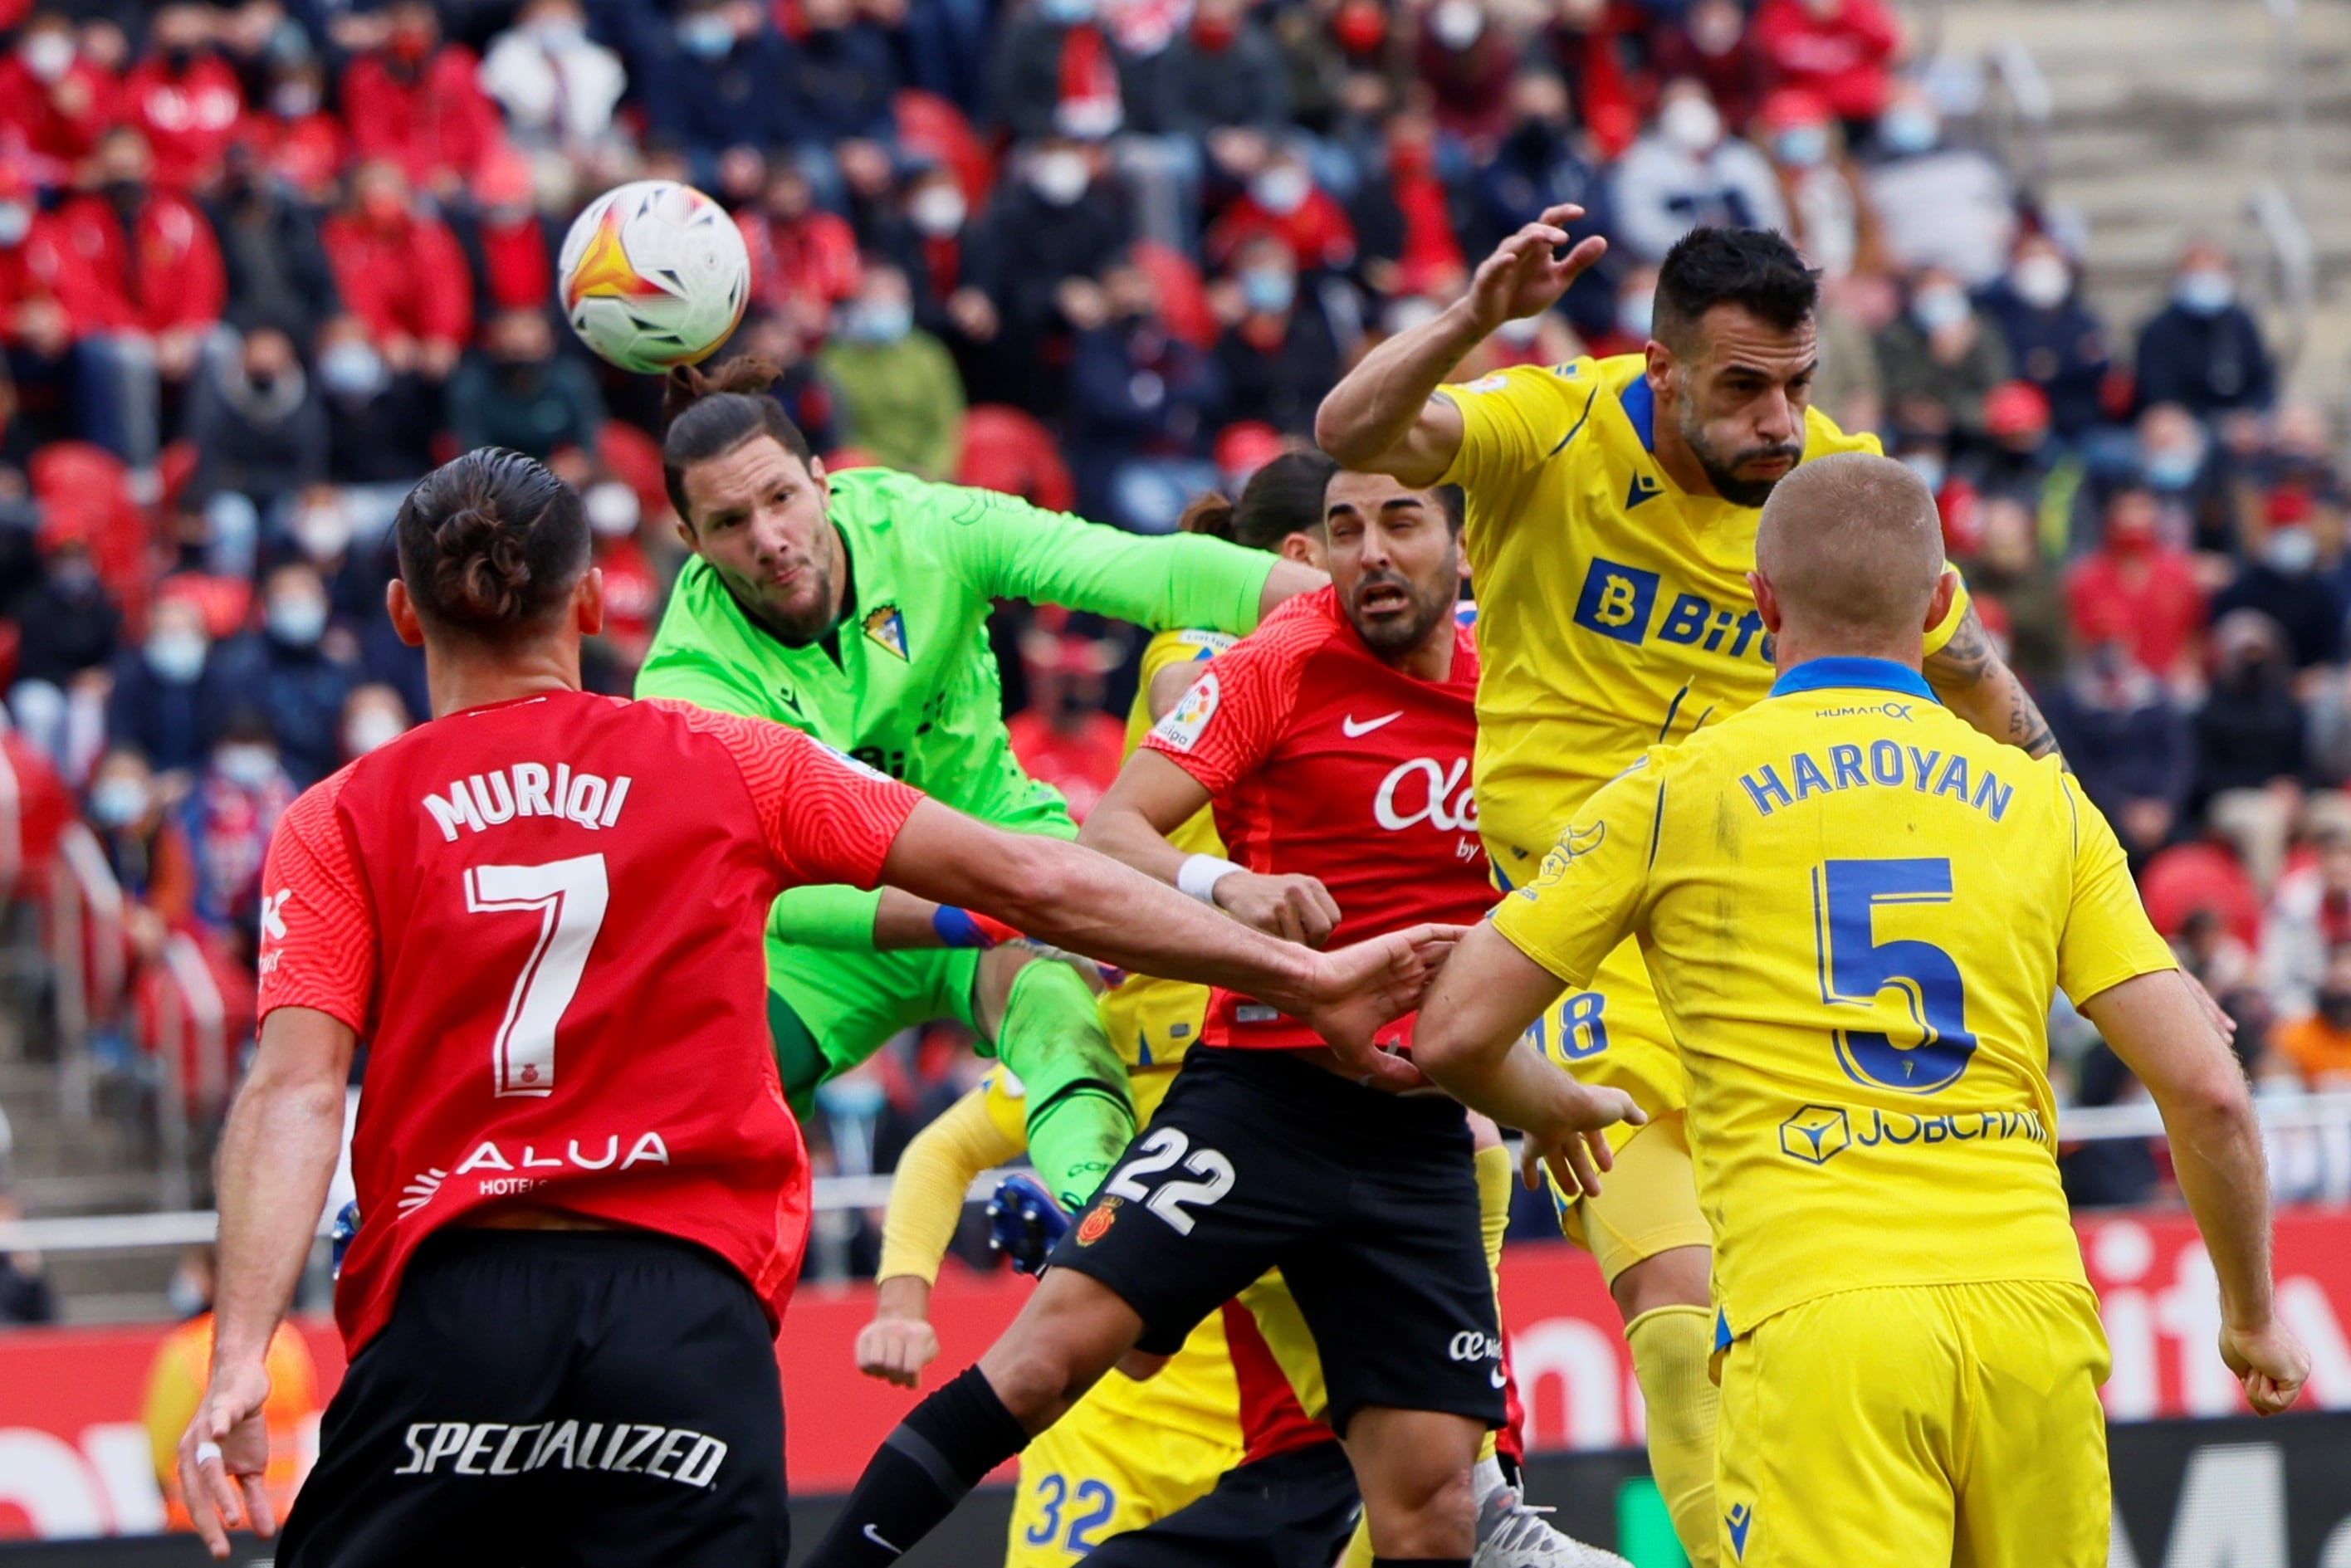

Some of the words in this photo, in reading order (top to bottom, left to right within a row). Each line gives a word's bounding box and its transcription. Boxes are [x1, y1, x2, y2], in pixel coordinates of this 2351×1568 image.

[422, 762, 633, 843] MURIQI
[1739, 740, 2014, 823] HAROYAN
[463, 852, 609, 1098] 7
[1811, 857, 1977, 1096] 5
[456, 1131, 669, 1175] ALUA
[479, 1177, 550, 1195] HOTE
[1105, 1126, 1235, 1237] 22
[394, 1419, 727, 1488] SPECIALIZED
[1026, 1473, 1114, 1556] 32
